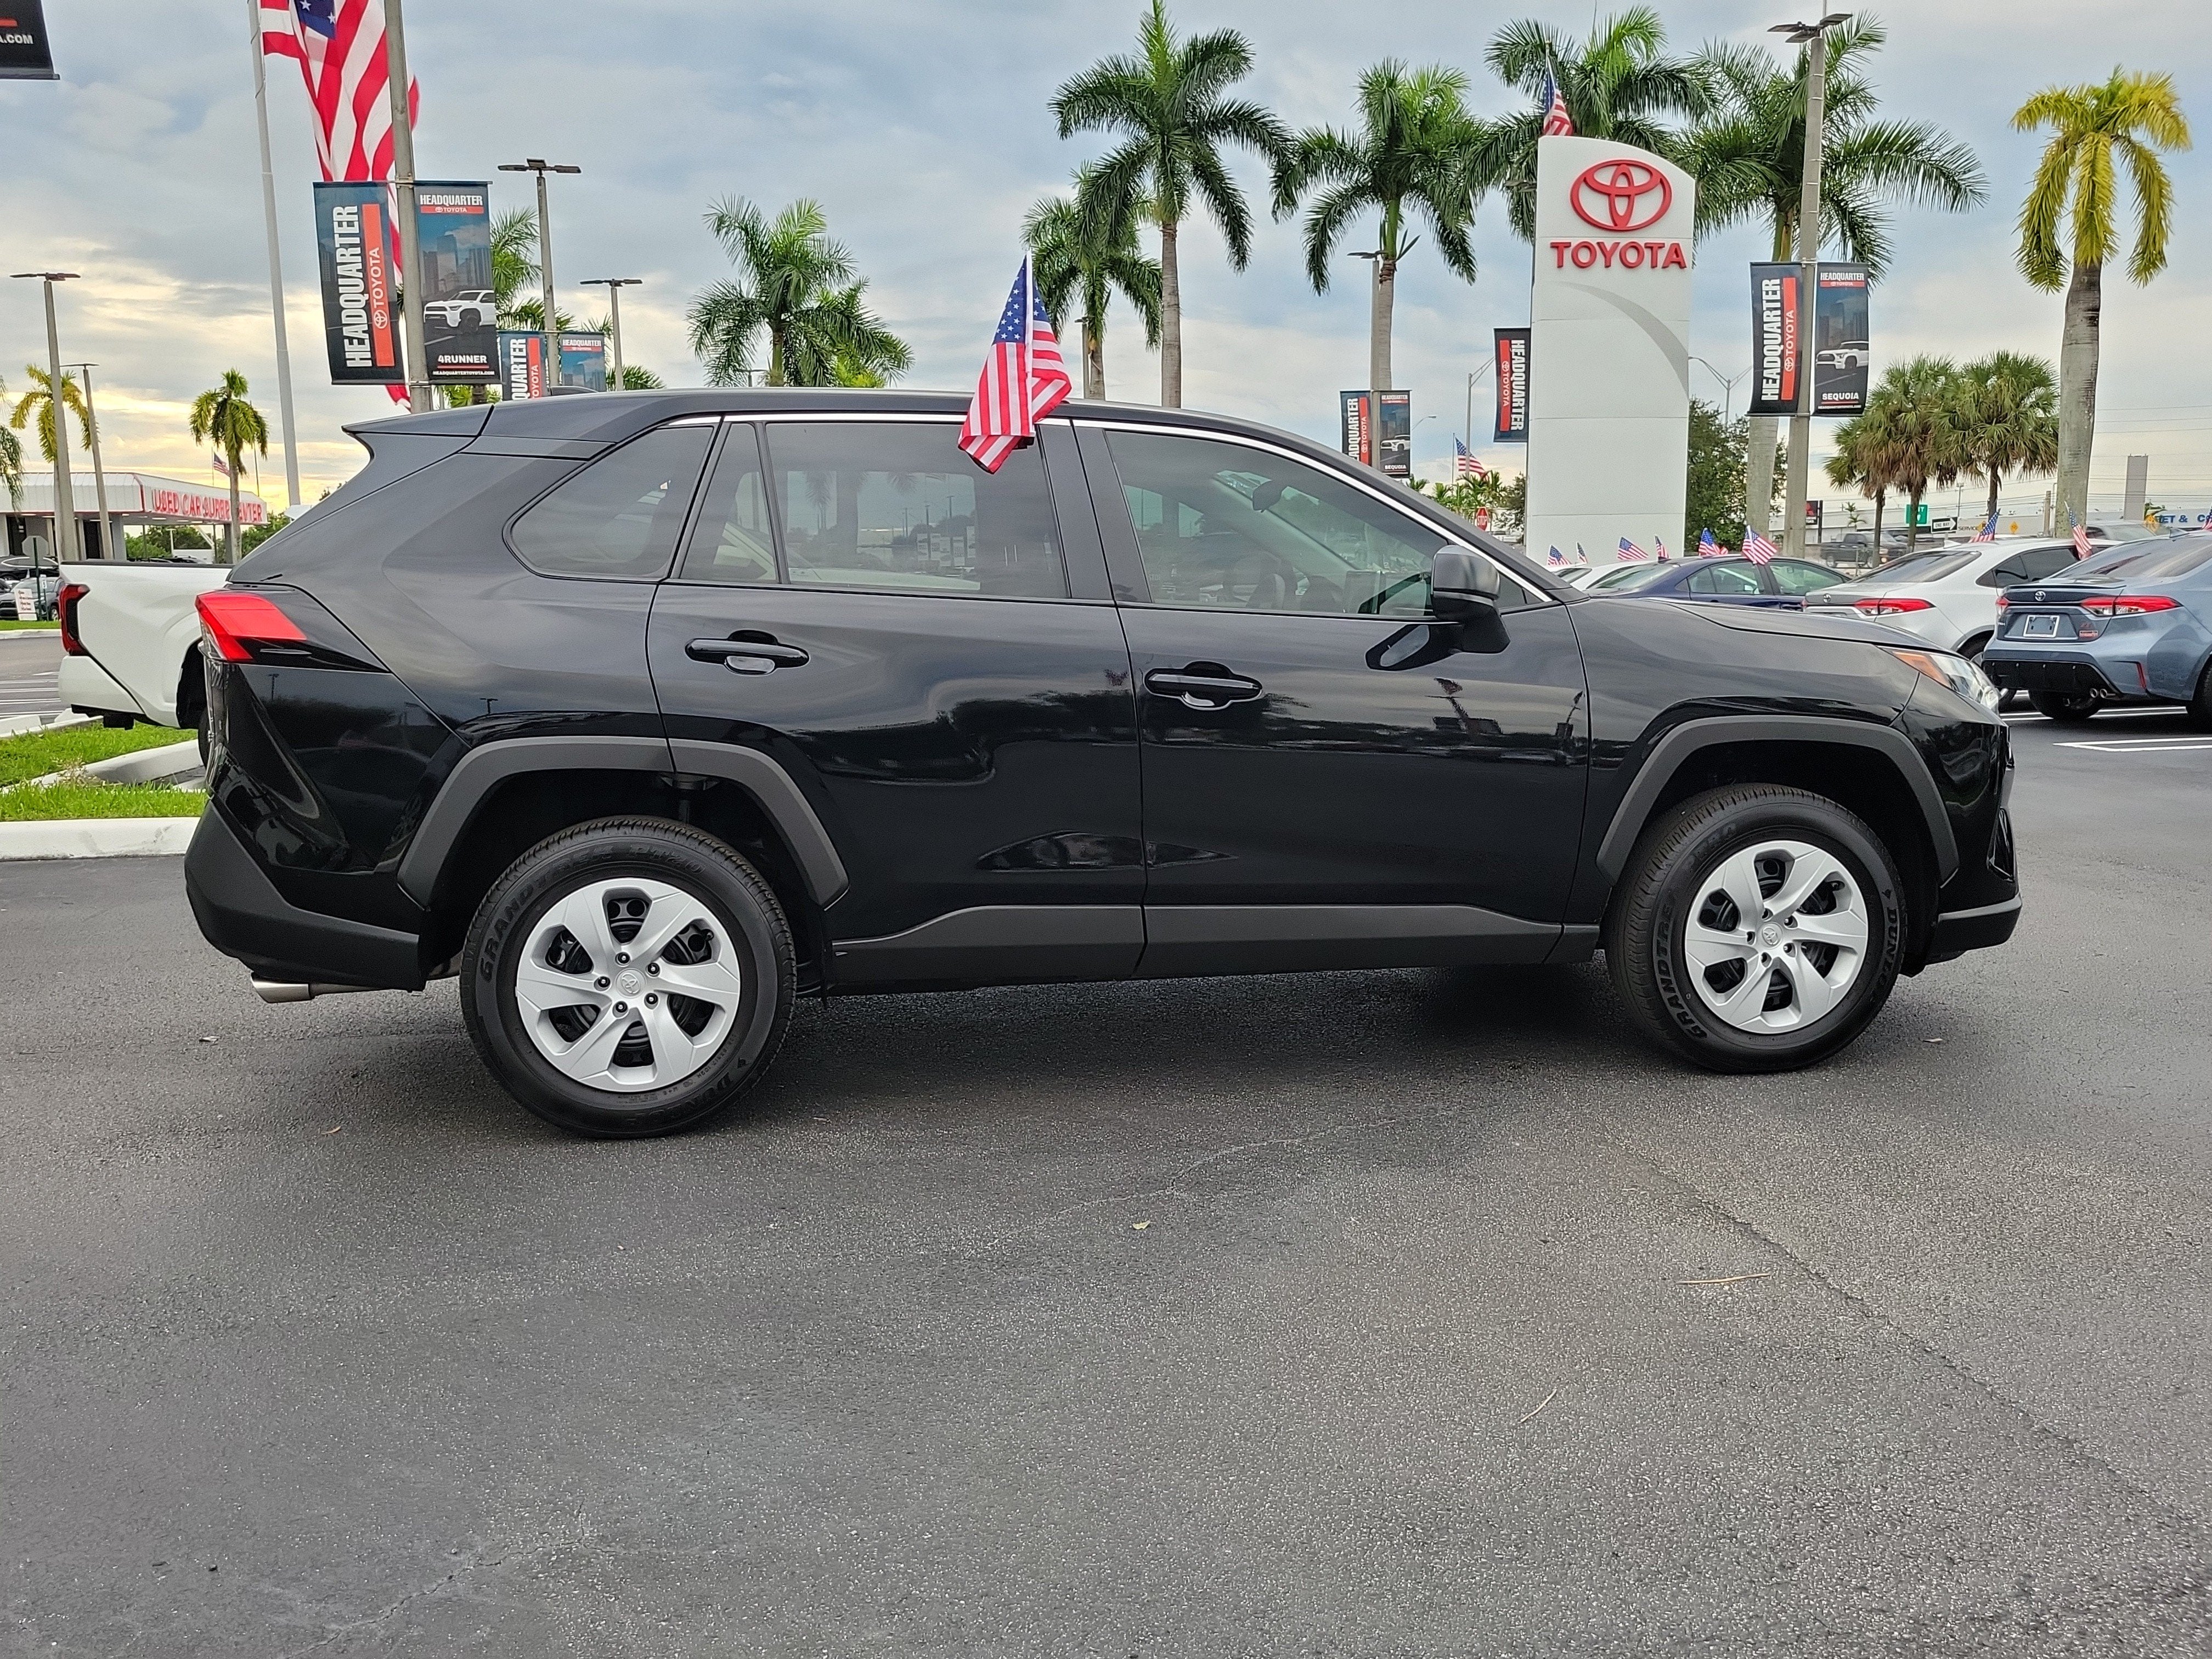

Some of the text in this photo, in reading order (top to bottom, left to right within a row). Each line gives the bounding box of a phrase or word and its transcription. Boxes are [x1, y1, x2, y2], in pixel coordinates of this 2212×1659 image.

[420, 194, 483, 206] HEADQUARTER
[1550, 241, 1686, 269] TOYOTA
[333, 205, 373, 368] HEADQUARTER
[369, 247, 385, 308] TOYOTA
[1820, 272, 1864, 281] HEADQUARTER
[1761, 279, 1783, 400] HEADQUARTER
[1786, 309, 1794, 356] TOYOTA
[438, 355, 488, 363] 4RUNNER
[510, 338, 530, 400] QUARTER
[531, 364, 540, 398] OYOTA
[1510, 340, 1525, 430] HEADQUARTER
[1822, 392, 1859, 401] SEQUOIA
[1347, 398, 1361, 461] ADQUARTER
[153, 489, 179, 514] USED
[182, 494, 200, 516] CAR
[239, 503, 262, 522] ENTER
[1477, 516, 1487, 526] STOP
